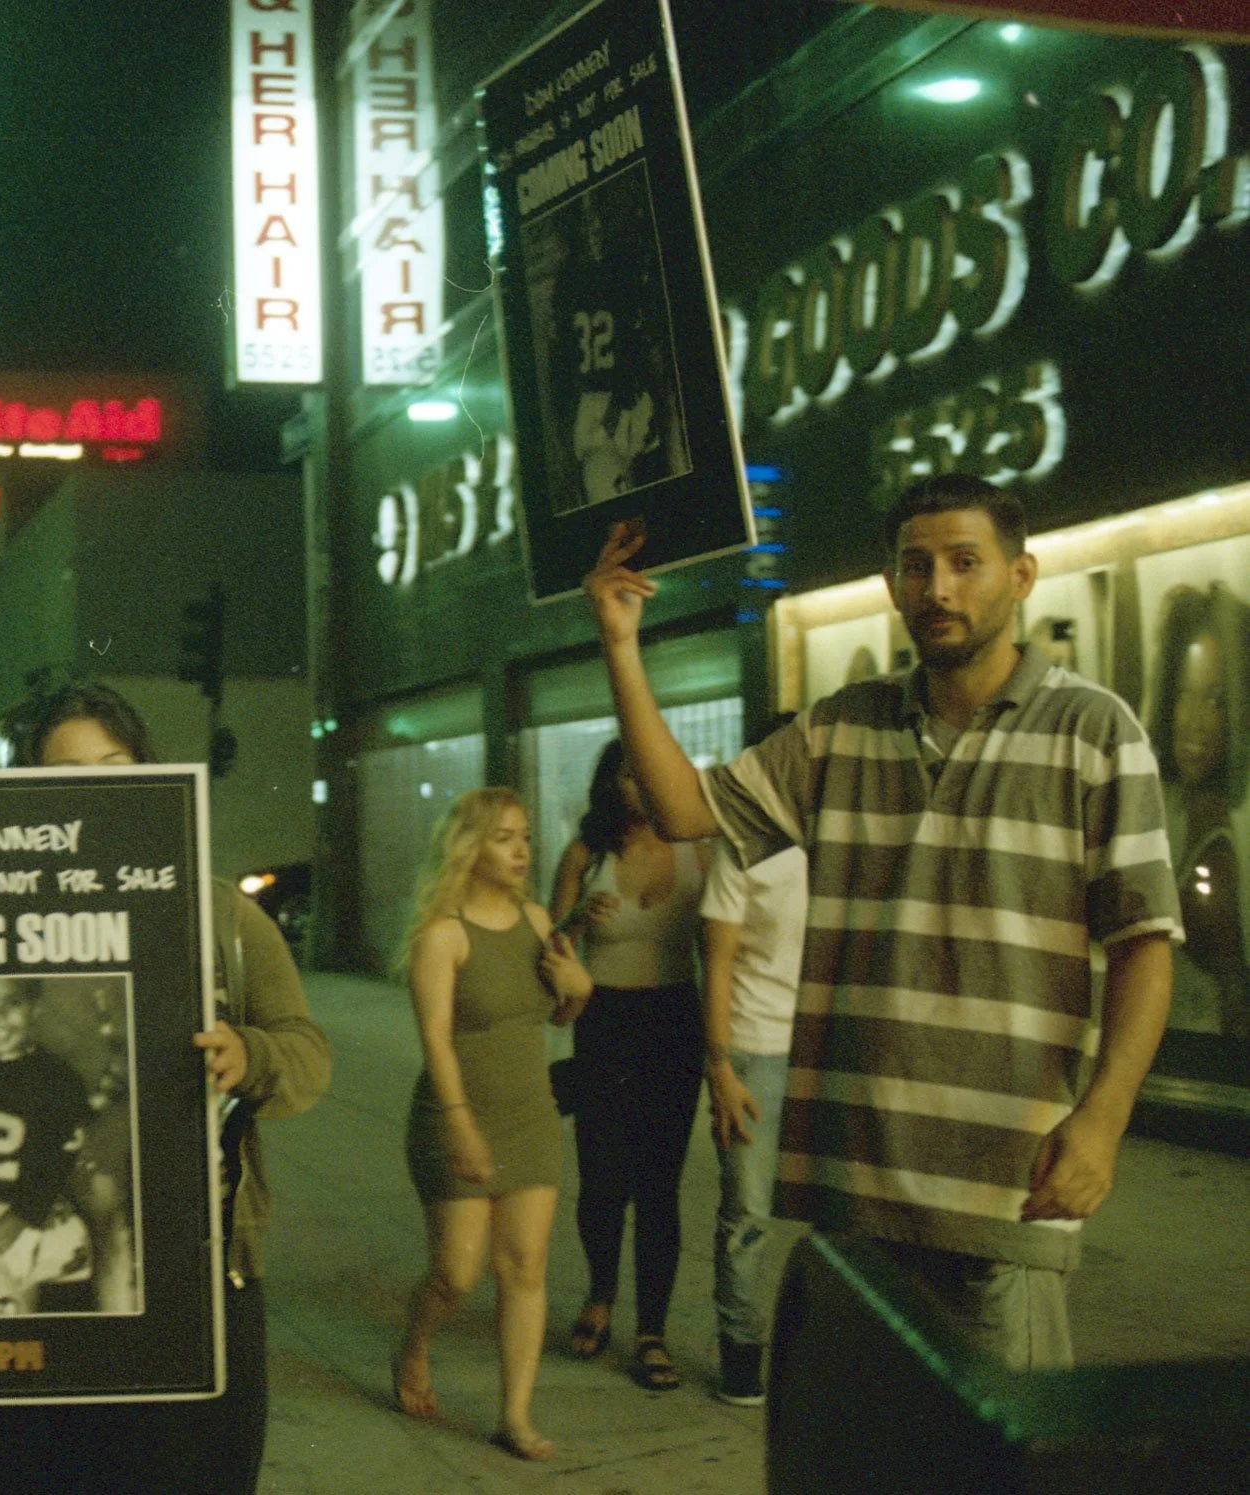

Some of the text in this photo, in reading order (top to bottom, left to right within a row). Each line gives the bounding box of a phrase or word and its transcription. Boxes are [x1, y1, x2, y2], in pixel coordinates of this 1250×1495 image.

[250, 32, 297, 145] HER
[517, 104, 645, 216] COMING SOON
[254, 171, 299, 331] HAIR
[572, 308, 615, 374] 32
[57, 868, 104, 893] FOR
[116, 865, 176, 891] SALE
[16, 911, 130, 964] SOON
